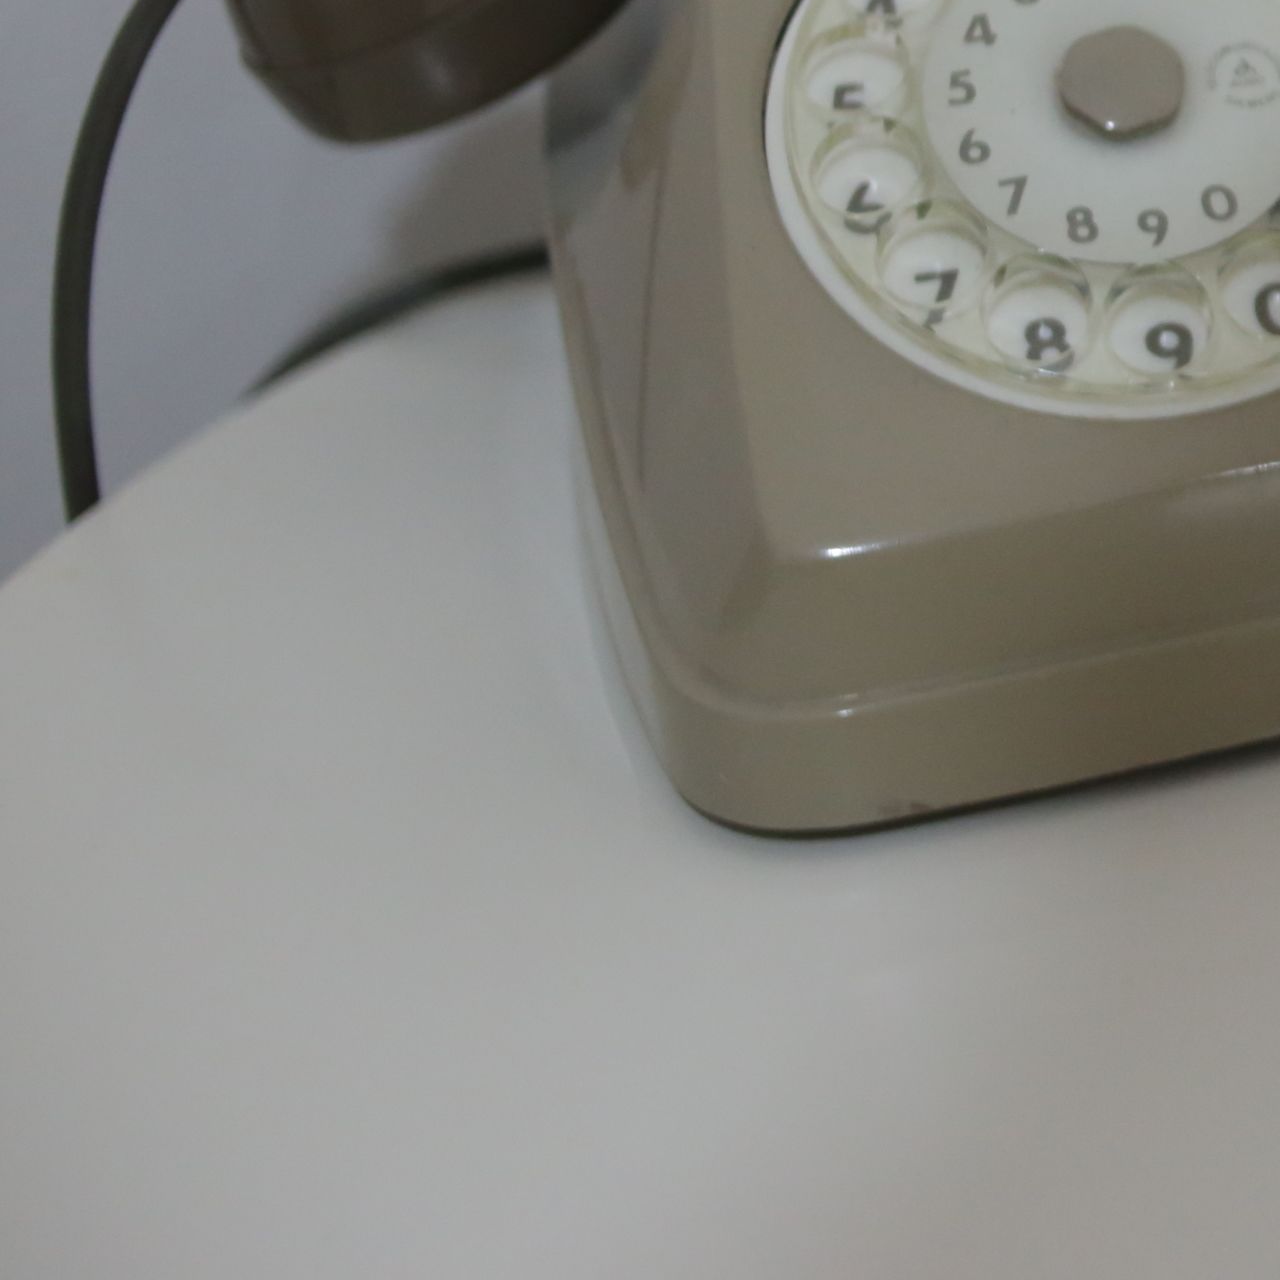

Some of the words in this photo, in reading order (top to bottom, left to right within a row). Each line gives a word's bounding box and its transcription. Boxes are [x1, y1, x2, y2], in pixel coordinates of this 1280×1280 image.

[963, 13, 998, 46] 4
[948, 68, 977, 106] 5
[959, 126, 991, 165] 6
[997, 174, 1029, 217] 7
[1200, 183, 1238, 222] 0
[1066, 205, 1099, 245] 8
[1136, 207, 1169, 248] 9
[913, 268, 960, 331] 7
[1024, 317, 1074, 371] 8
[1145, 322, 1194, 371] 9
